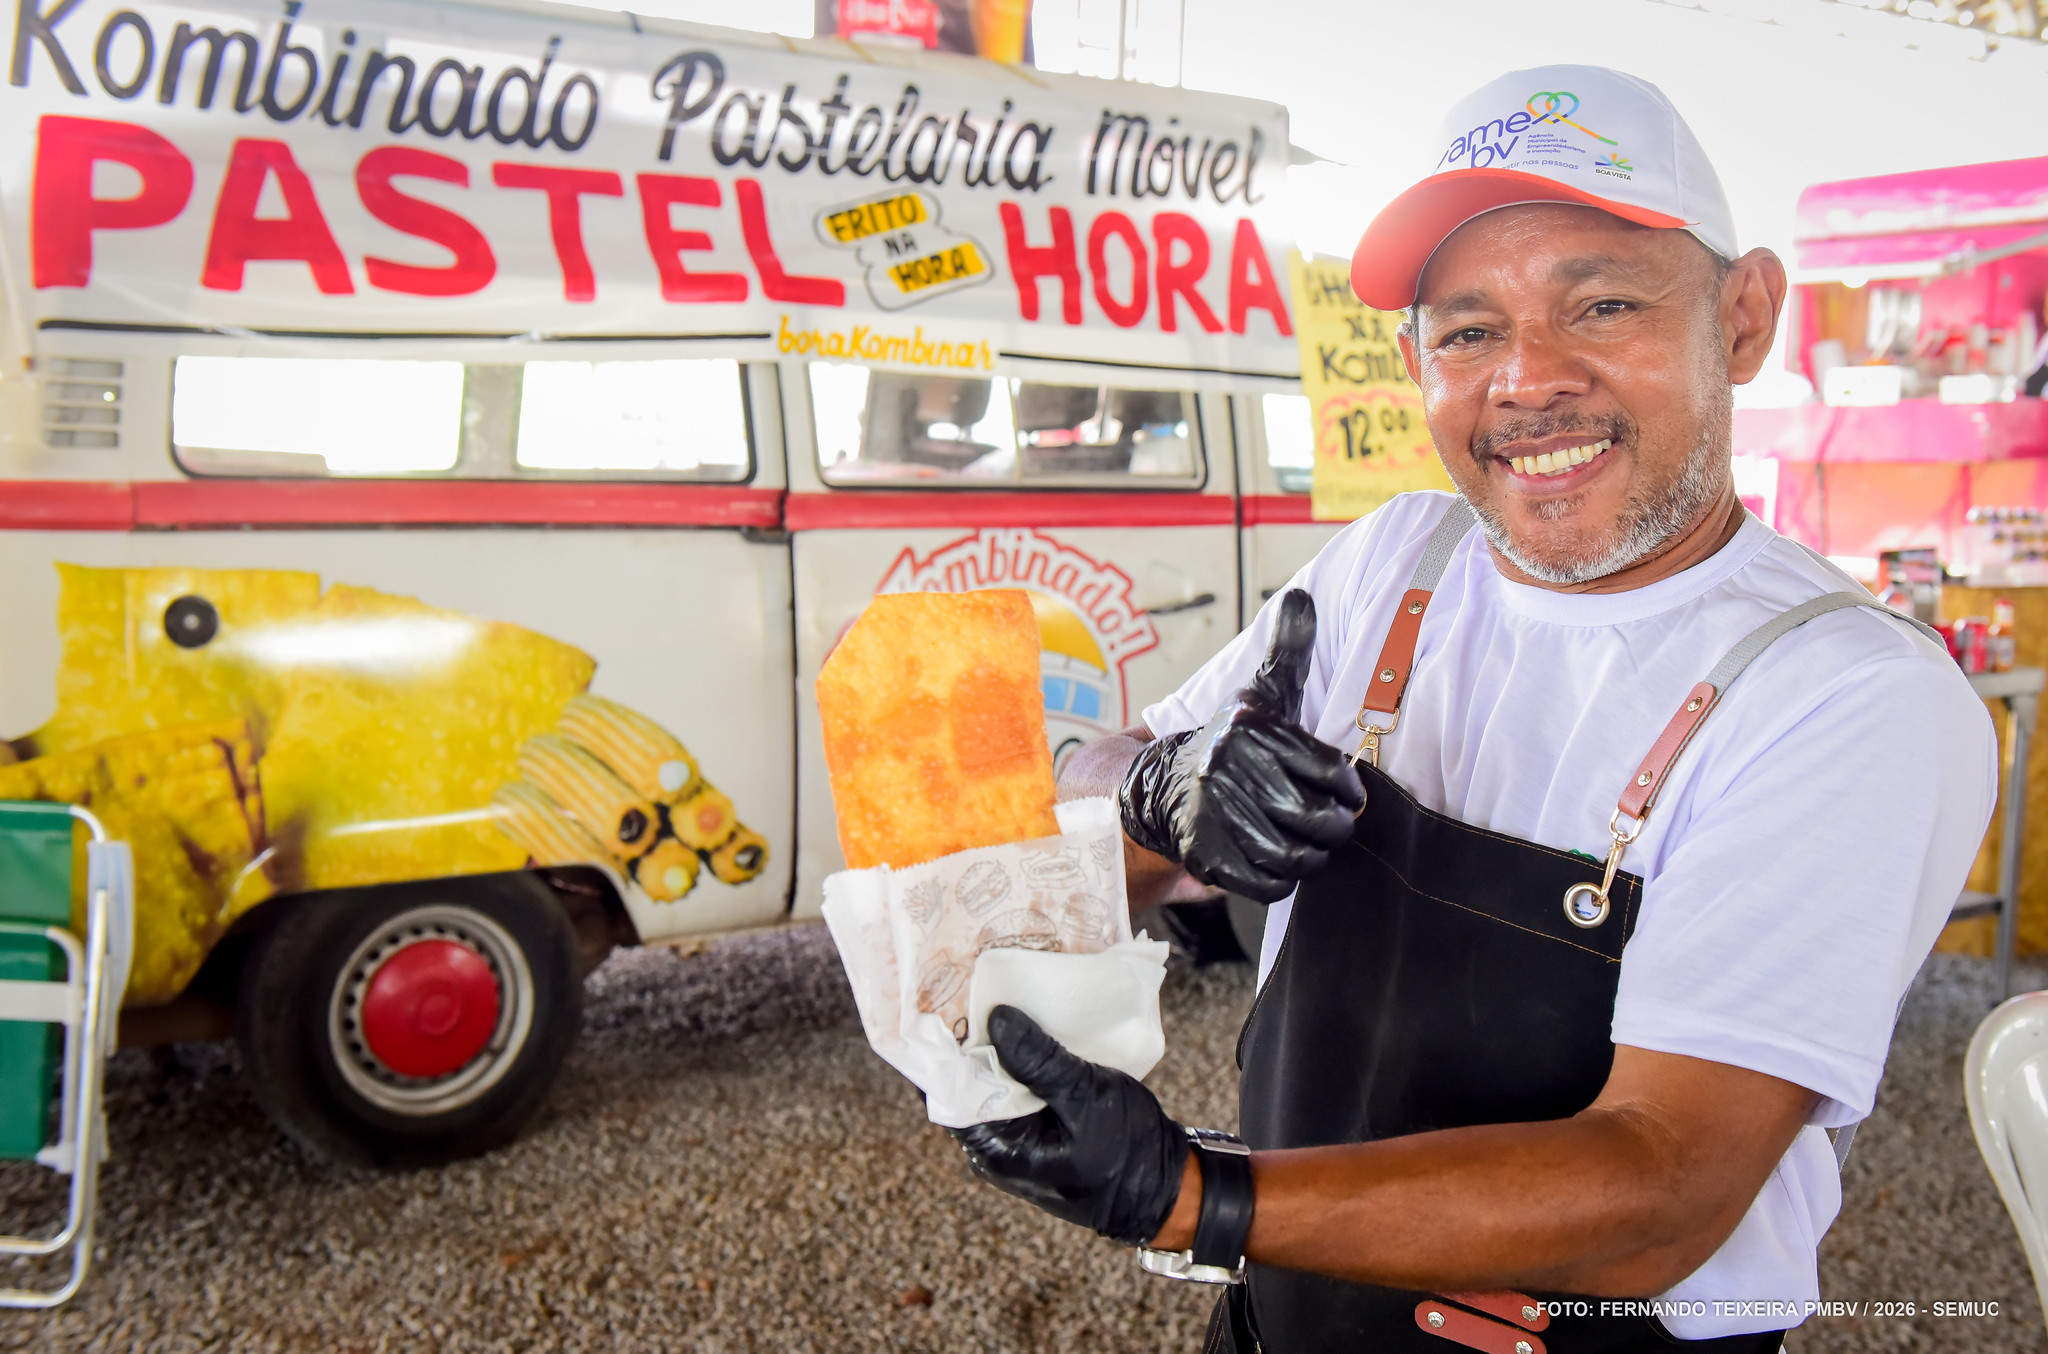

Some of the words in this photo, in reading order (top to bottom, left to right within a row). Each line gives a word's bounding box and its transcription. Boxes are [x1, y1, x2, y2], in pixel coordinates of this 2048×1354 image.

[10, 0, 599, 152] Kombinado
[652, 51, 1054, 192] Pastelaria
[1541, 159, 1579, 170] pessoas
[32, 114, 845, 307] PASTEL
[1000, 202, 1293, 336] HORA
[828, 195, 918, 242] FRITO
[884, 233, 918, 256] NA
[896, 247, 970, 292] HORA
